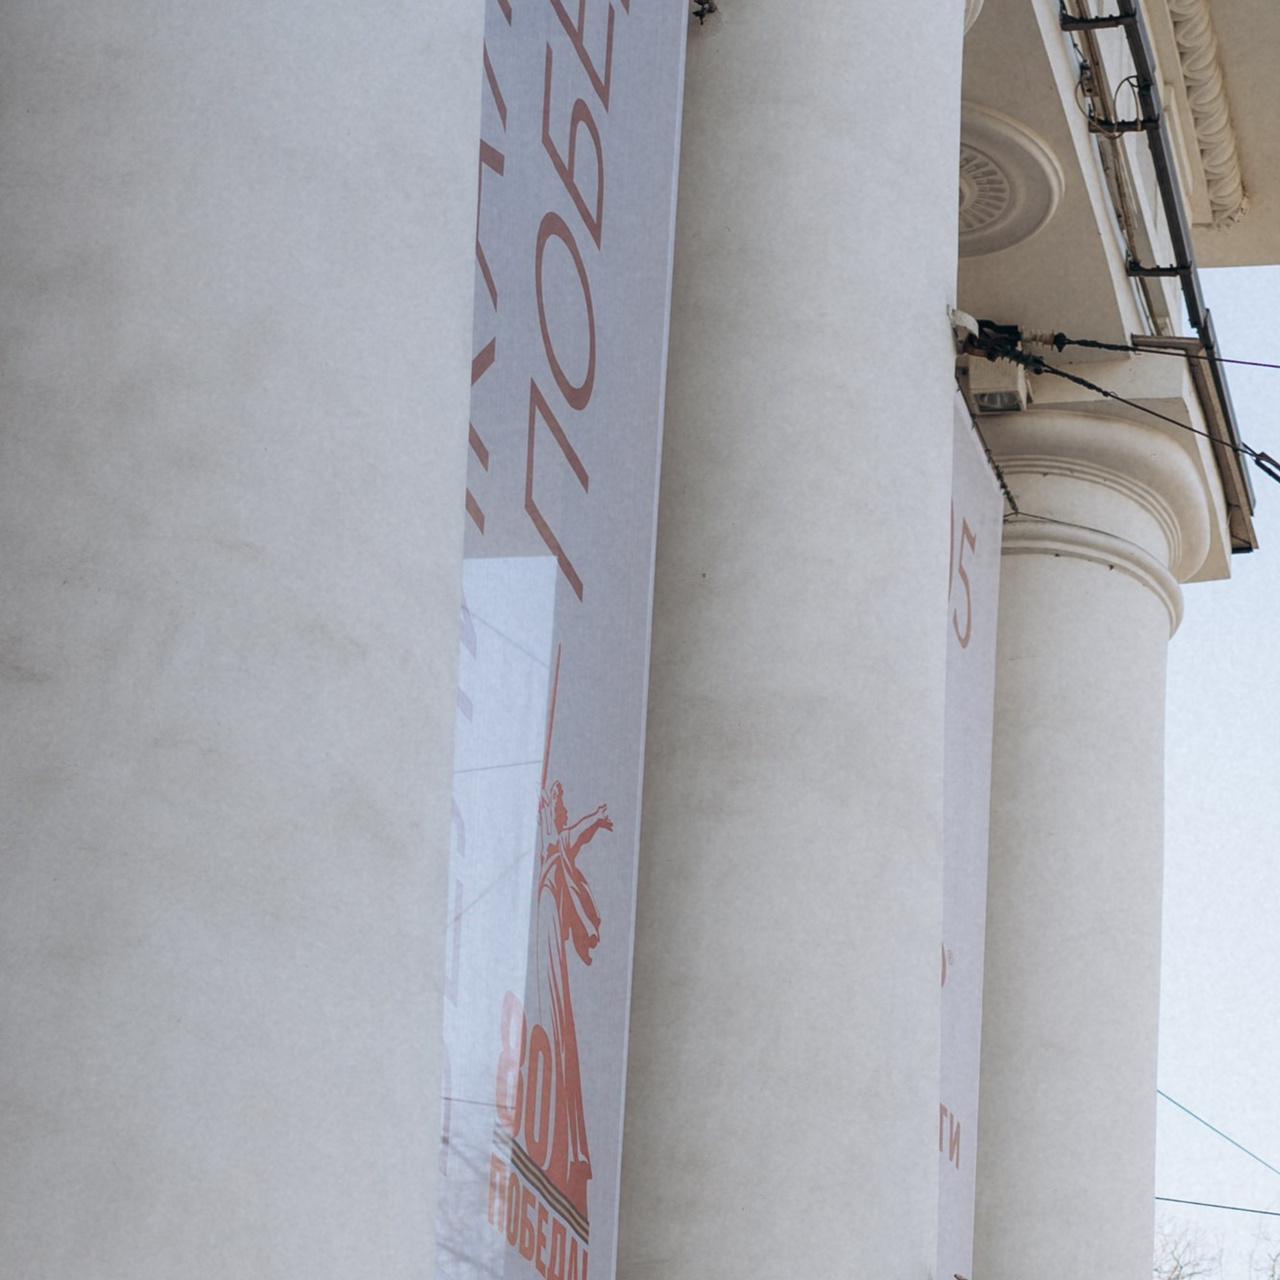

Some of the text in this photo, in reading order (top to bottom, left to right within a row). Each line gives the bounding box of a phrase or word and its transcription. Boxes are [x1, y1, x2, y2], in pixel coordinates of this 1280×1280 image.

[524, 0, 630, 603] ПОБЕ
[948, 498, 976, 649] 5
[495, 989, 552, 1171] 80
